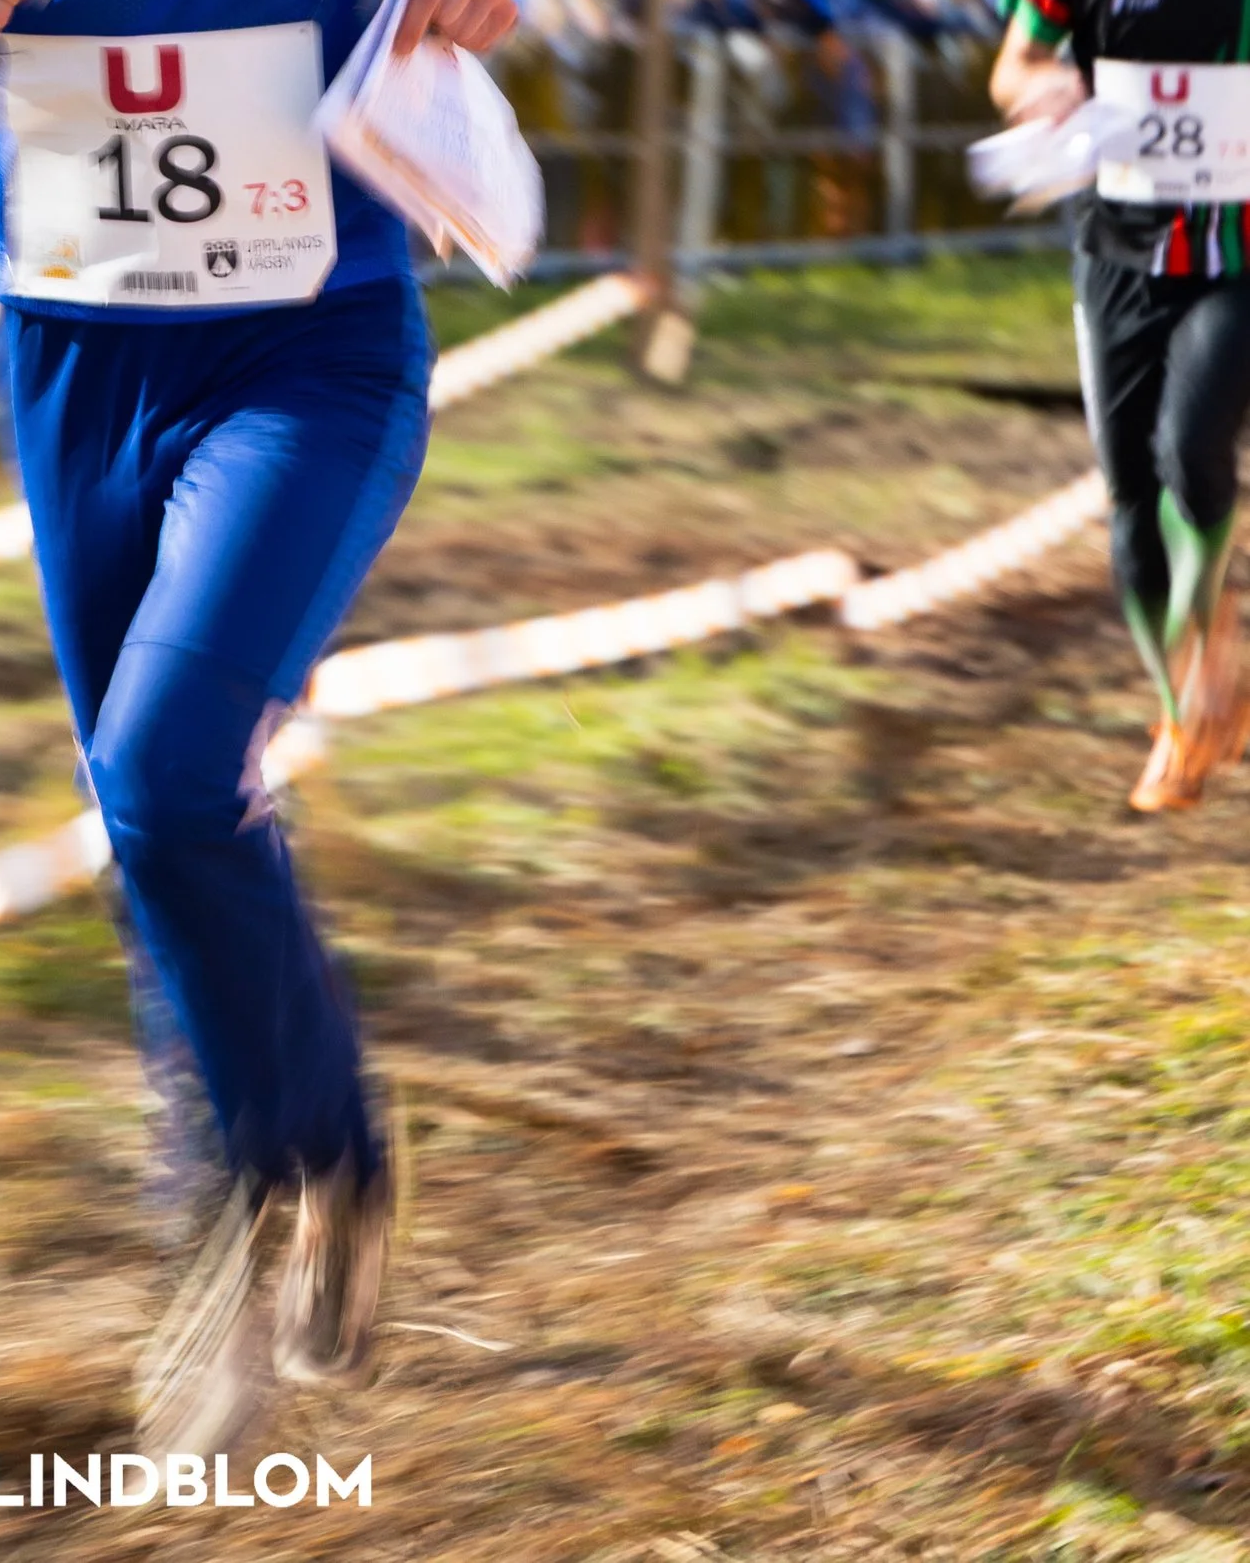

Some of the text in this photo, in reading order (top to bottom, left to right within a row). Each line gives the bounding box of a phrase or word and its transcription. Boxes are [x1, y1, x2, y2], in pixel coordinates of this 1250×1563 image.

[103, 44, 186, 115] U
[1150, 66, 1191, 107] U
[1137, 112, 1206, 158] 28
[91, 133, 223, 224] 18
[243, 178, 309, 217] 7:3
